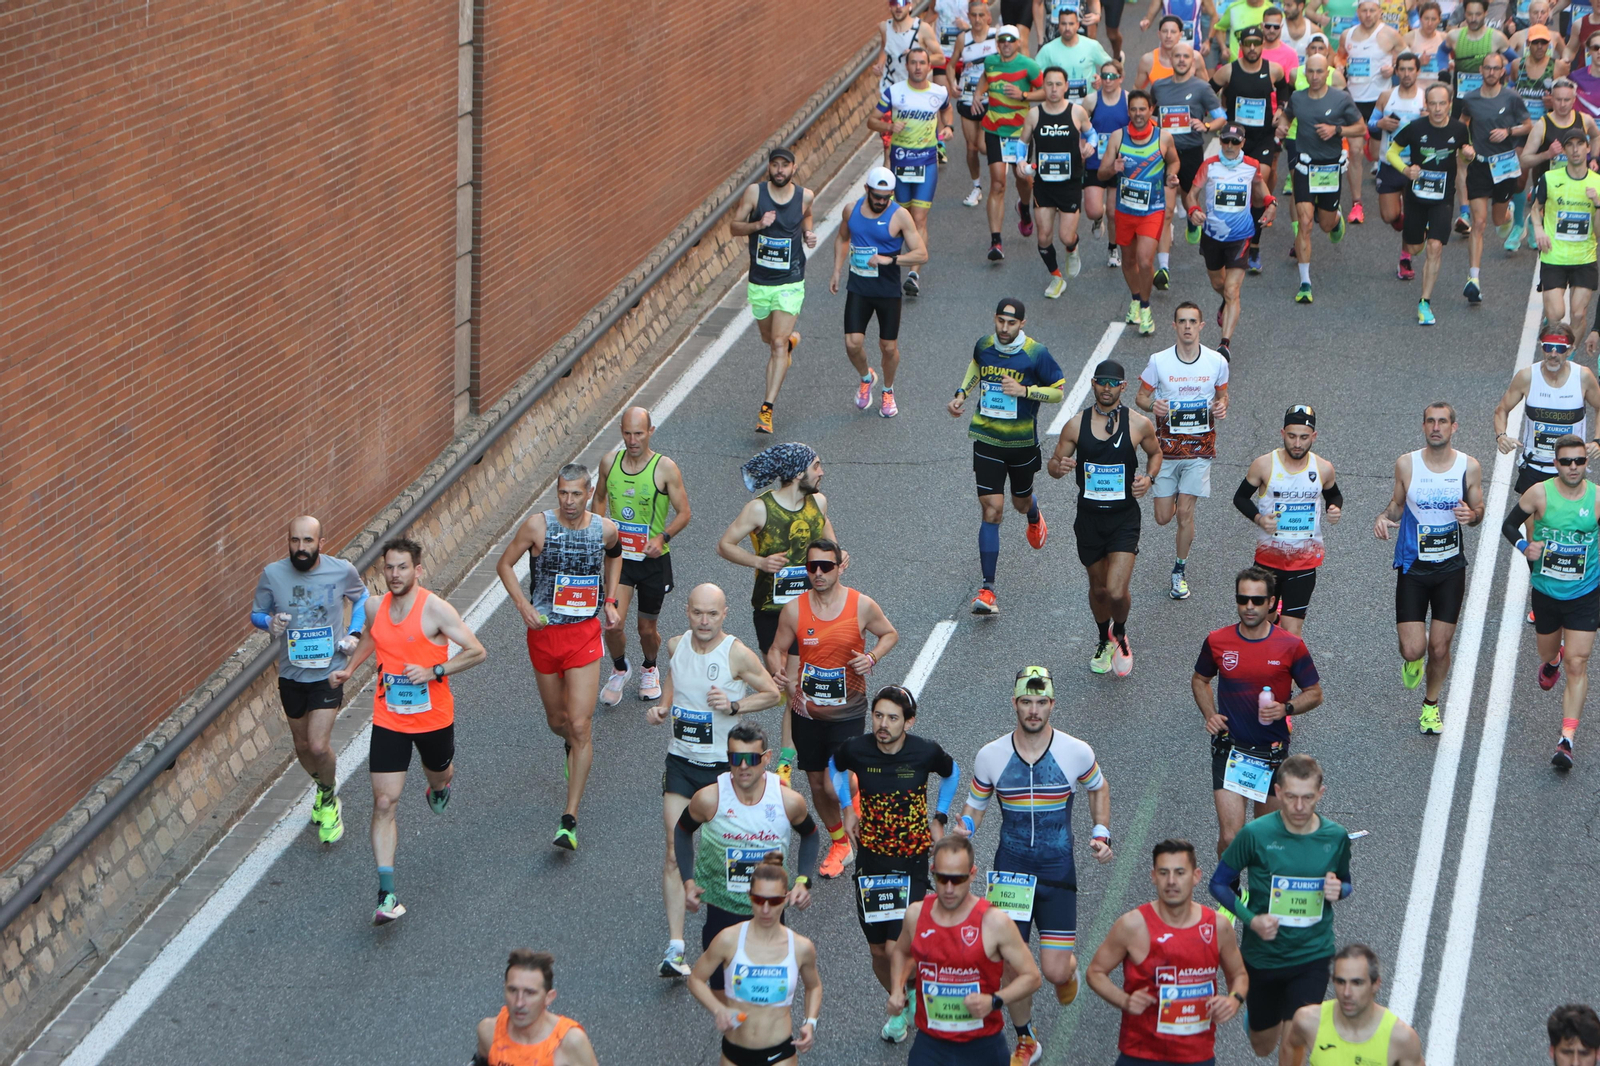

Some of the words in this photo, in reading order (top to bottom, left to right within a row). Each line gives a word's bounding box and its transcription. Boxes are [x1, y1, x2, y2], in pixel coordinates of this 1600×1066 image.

[980, 366, 1024, 382] UBUNTU
[1433, 524, 1454, 533] ZURICH
[302, 630, 327, 638] ZURICH
[1242, 770, 1256, 780] 4054
[722, 830, 780, 841] maratón
[876, 878, 904, 886] ZURICH
[1002, 876, 1029, 885] ZURICH
[1292, 881, 1320, 889] ZURICH
[878, 892, 894, 902] 2519
[1000, 891, 1016, 899] 1623
[989, 900, 1030, 910] ATLETACUERDO
[752, 968, 782, 976] ZURICH
[941, 987, 971, 995] ZURICH
[1181, 987, 1208, 996] ZURICH
